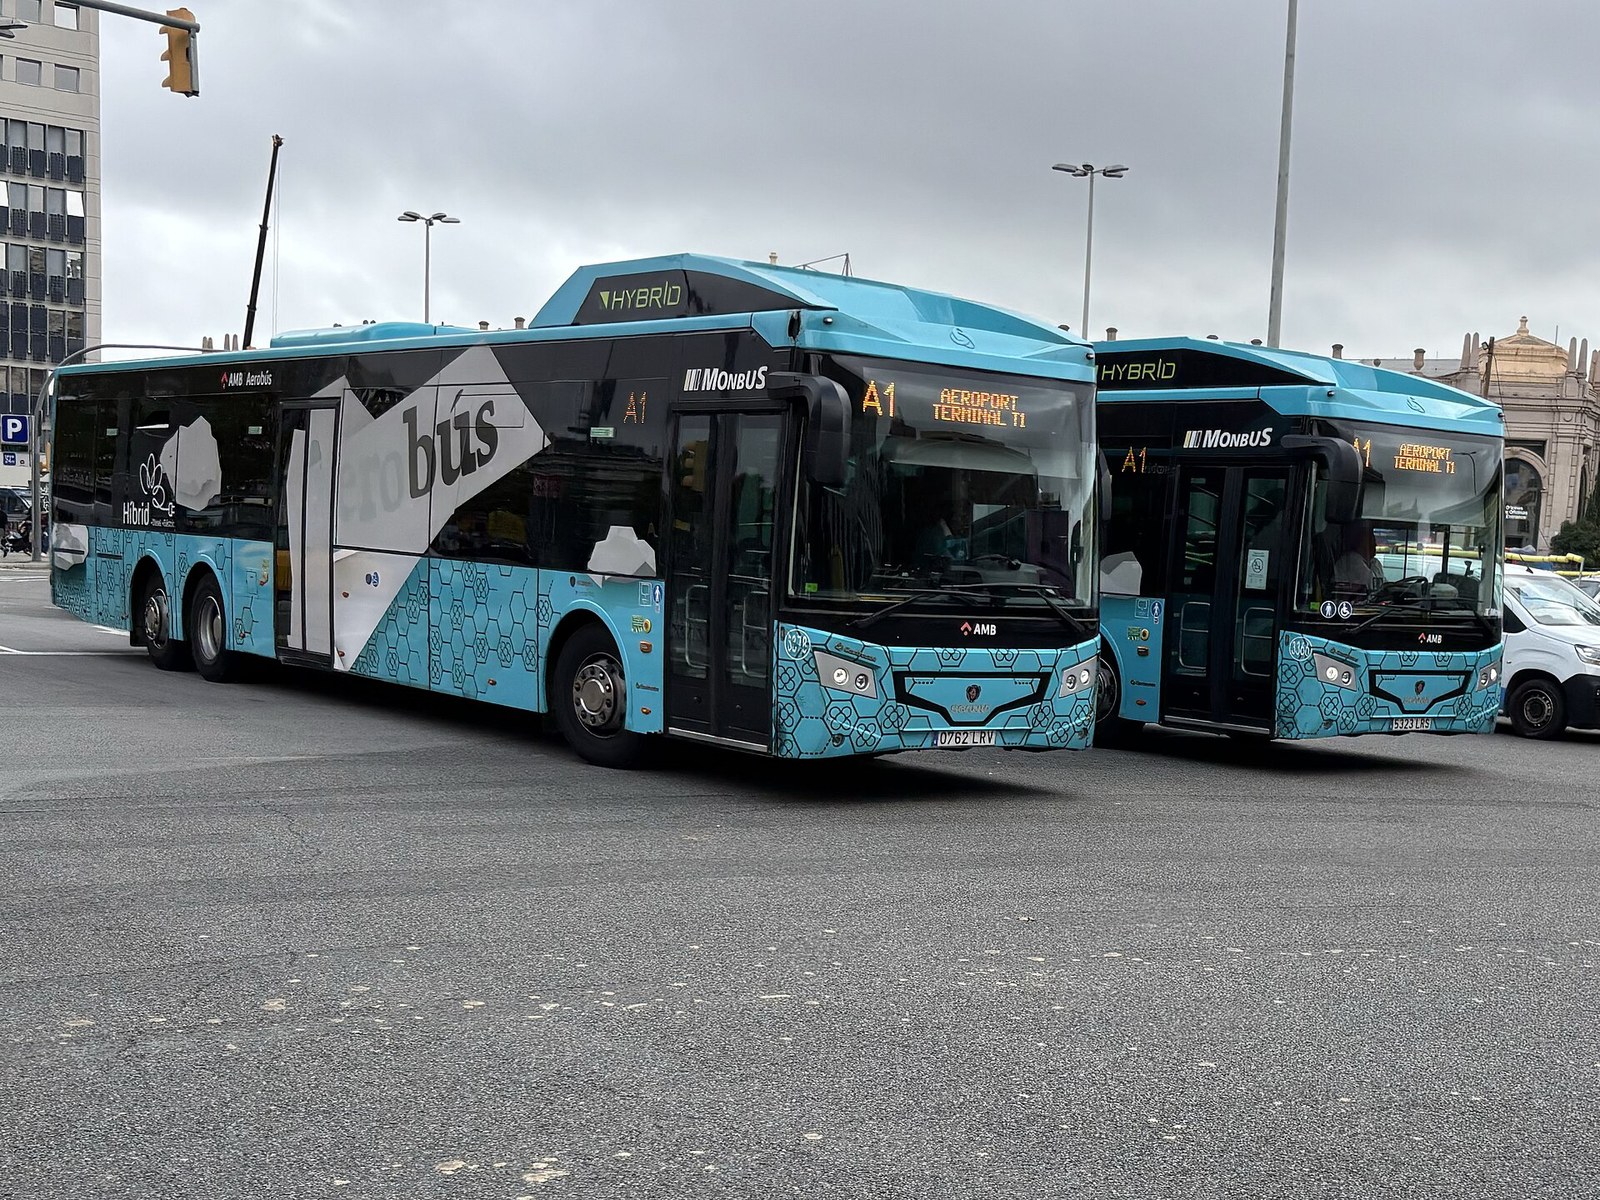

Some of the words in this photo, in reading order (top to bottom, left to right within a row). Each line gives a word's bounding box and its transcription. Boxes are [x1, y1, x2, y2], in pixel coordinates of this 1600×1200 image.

[611, 281, 681, 310] HYBRID
[228, 372, 243, 387] AMB
[246, 370, 272, 386] Aerobús
[701, 366, 768, 391] MONBUS
[1101, 358, 1176, 381] HYBRID
[623, 391, 647, 423] A1
[863, 380, 895, 417] A1
[940, 388, 1019, 411] AEROPORT
[932, 404, 1007, 426] TERMINAL
[1011, 412, 1026, 428] T1
[6, 418, 22, 439] P
[1202, 427, 1273, 448] MONBUS
[1121, 446, 1147, 473] A1
[1400, 443, 1451, 460] AEROPORT
[1394, 456, 1442, 473] TERMINAL
[1446, 461, 1455, 474] T1
[973, 623, 997, 636] AMB
[1426, 633, 1442, 644] AMB
[940, 731, 969, 745] 0762
[972, 731, 994, 744] LRV
